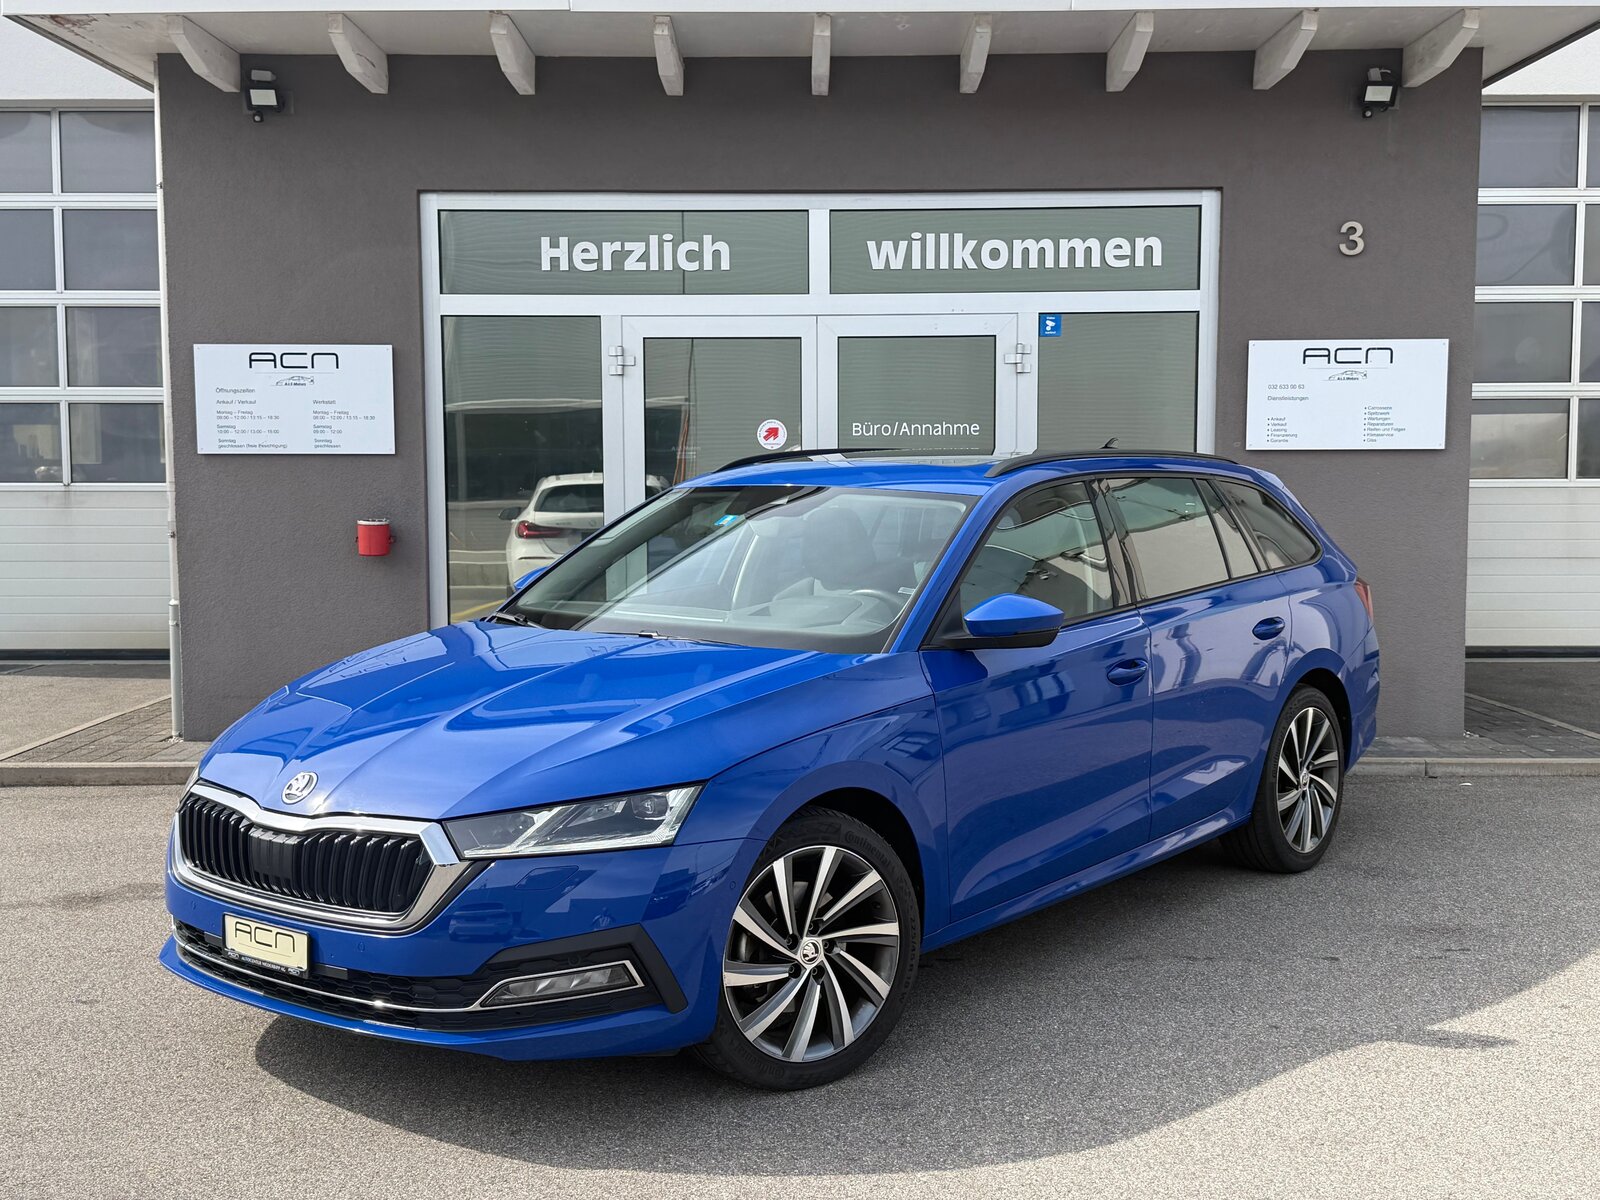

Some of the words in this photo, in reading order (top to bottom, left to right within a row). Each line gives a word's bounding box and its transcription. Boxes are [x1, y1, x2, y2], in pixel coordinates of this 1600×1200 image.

[541, 233, 730, 271] Herzlich
[866, 232, 1162, 270] willkommen
[1339, 221, 1364, 256] 3
[249, 352, 339, 369] ACN
[1303, 347, 1393, 364] ACN
[852, 421, 980, 437] Büro/Annahme
[844, 830, 892, 868] Continental
[235, 921, 295, 952] ACN
